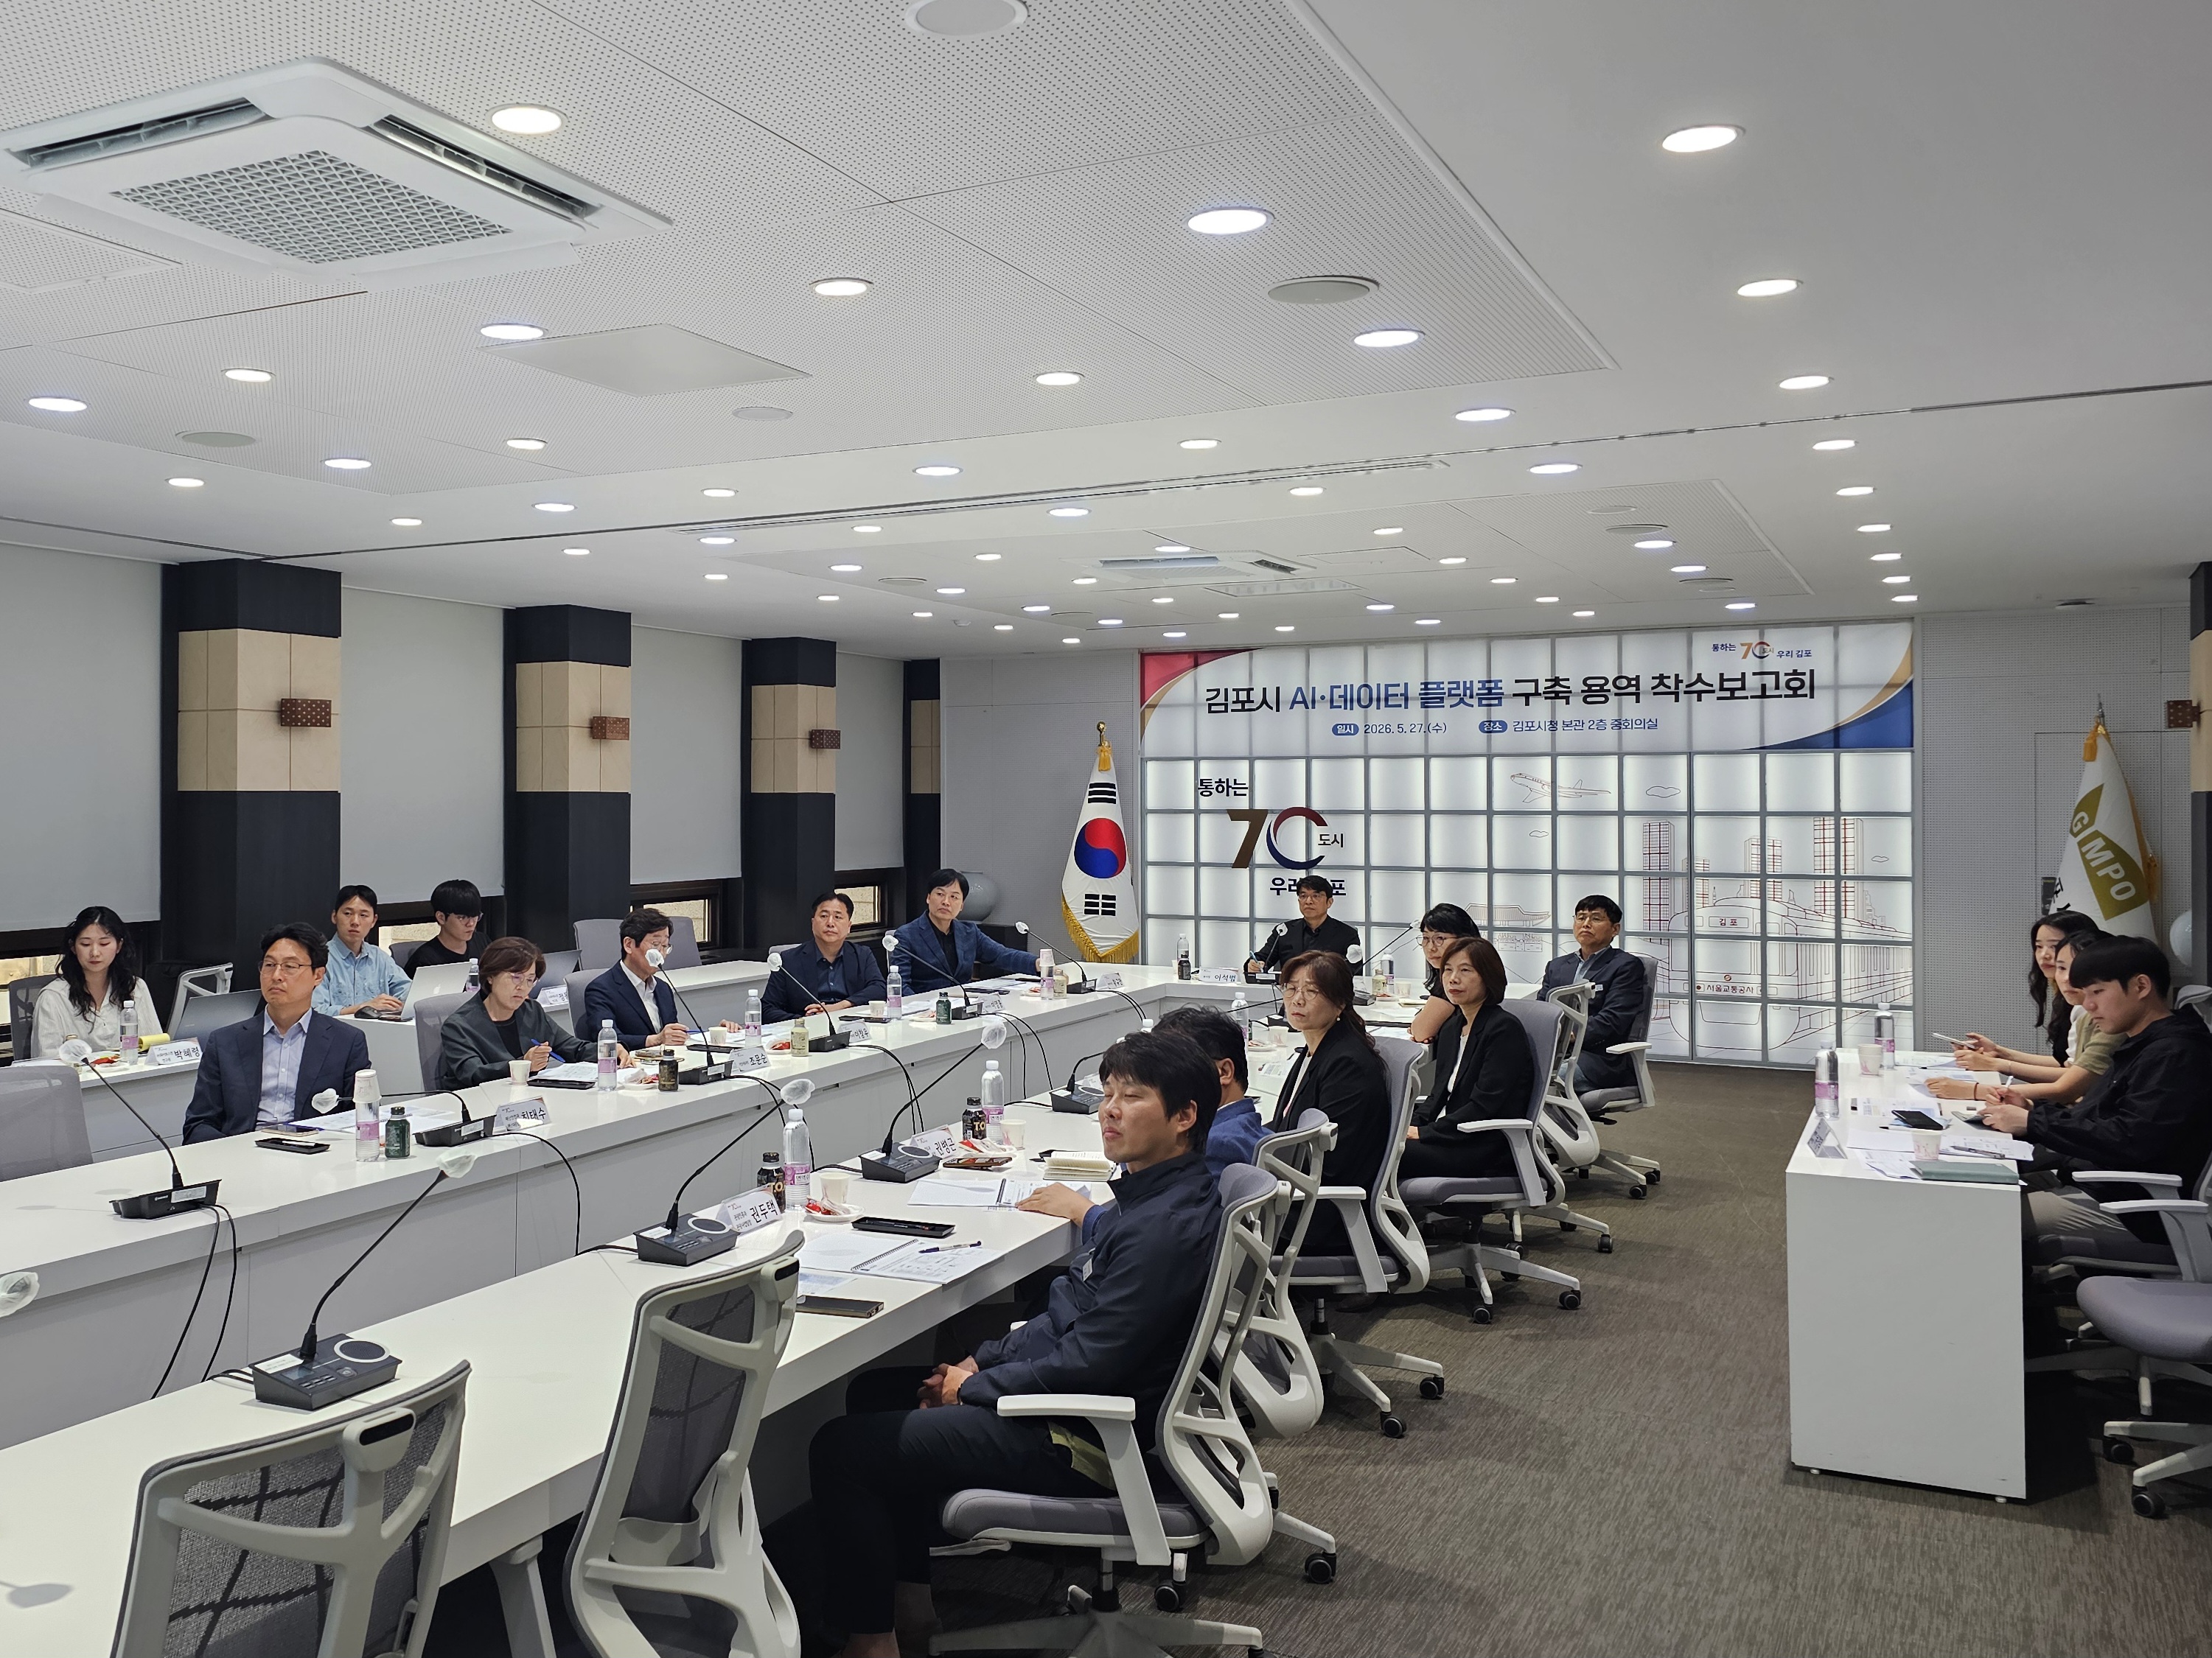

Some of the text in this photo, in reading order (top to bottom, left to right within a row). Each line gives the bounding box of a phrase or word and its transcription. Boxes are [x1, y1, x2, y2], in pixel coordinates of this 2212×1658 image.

[1712, 643, 1737, 652] 통하는
[1776, 650, 1793, 658] 우리
[1796, 649, 1812, 658] 김포
[1205, 686, 1281, 714] 김포시
[1418, 679, 1504, 709] 플랫폼
[1512, 676, 1573, 707] 구축
[1580, 674, 1641, 705] 용역
[1650, 668, 1815, 703] 착수보고회
[1336, 724, 1355, 735] 일시
[1364, 722, 1448, 735] 2026. 5. 27.(수)
[1483, 721, 1504, 732] 장소
[1513, 718, 1658, 732] 김포시청 본관 2층 중회의실
[1198, 777, 1249, 797] 통하는
[1317, 833, 1344, 848] 도시
[2072, 811, 2136, 901] GIMPO
[1706, 984, 1754, 994] 서울교통공사
[174, 1046, 200, 1060] 박혜령
[934, 1137, 957, 1156] 권병근
[749, 1198, 778, 1224] 권두택
